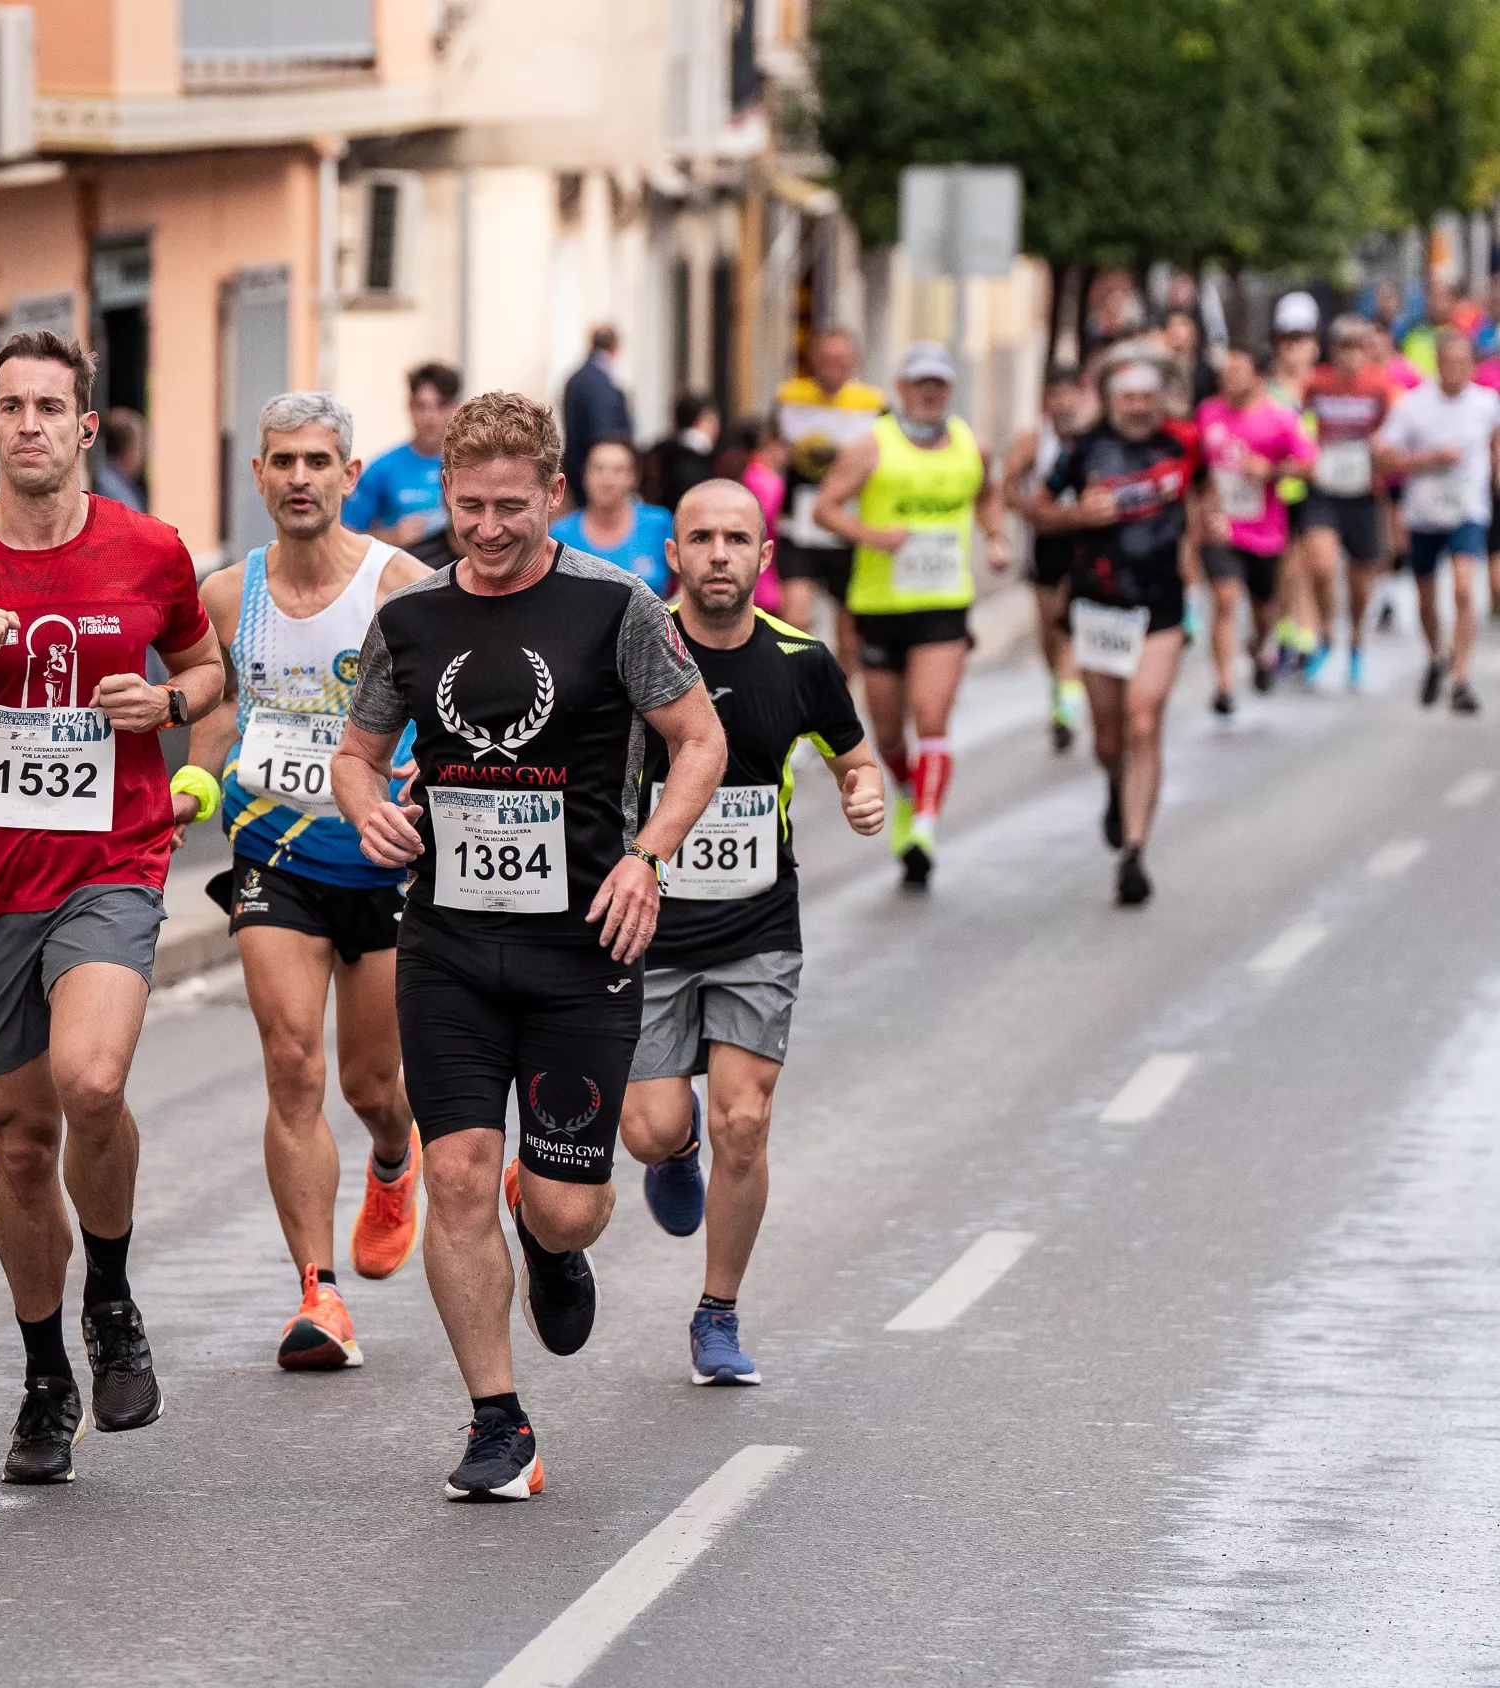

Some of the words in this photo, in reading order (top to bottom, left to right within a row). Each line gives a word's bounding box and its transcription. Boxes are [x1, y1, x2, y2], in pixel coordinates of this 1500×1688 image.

[87, 625, 121, 634] GRANADA
[8, 711, 43, 720] PROVINCIAL
[14, 718, 51, 726] POPULARES
[52, 712, 86, 727] 2024
[258, 758, 334, 795] 150
[437, 764, 513, 784] HERMES
[515, 766, 567, 785] GYM
[457, 792, 487, 801] PROVINCIAL
[462, 799, 496, 808] POPULARES
[496, 794, 531, 809] 2024
[721, 790, 752, 804] 2024
[676, 835, 757, 870] 1381
[454, 841, 551, 881] 1384
[526, 1133, 574, 1155] HERMES
[575, 1145, 605, 1157] GYM
[535, 1149, 591, 1168] Training
